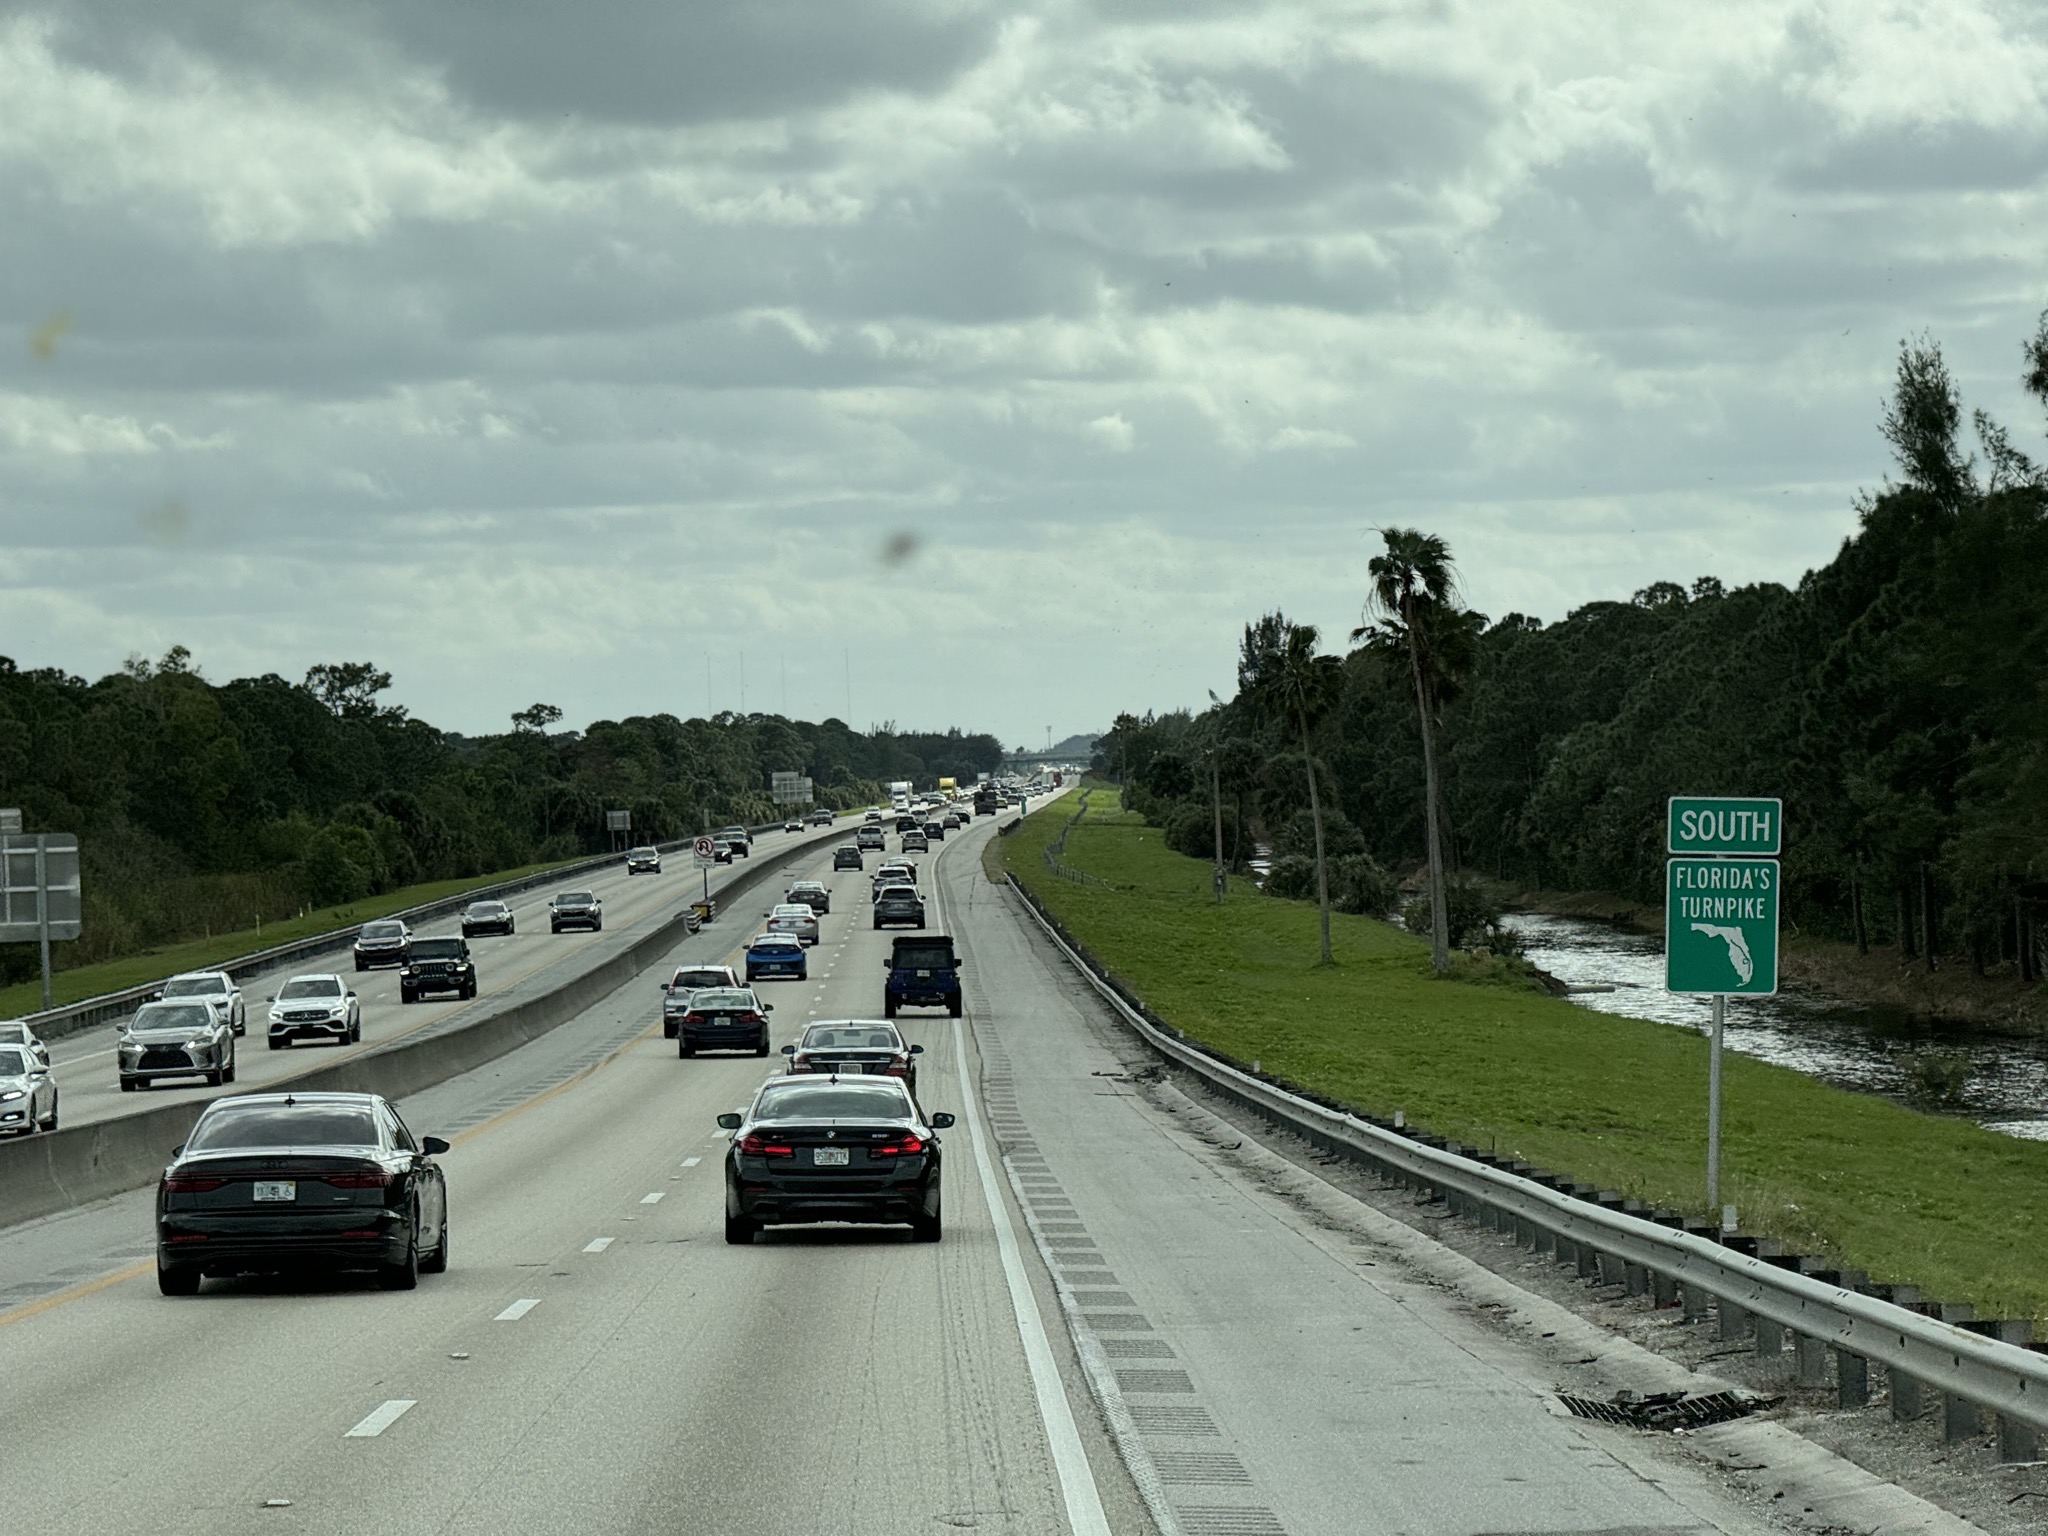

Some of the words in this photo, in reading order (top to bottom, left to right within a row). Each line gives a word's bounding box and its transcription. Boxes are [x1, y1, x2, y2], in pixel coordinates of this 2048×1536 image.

[1680, 810, 1770, 841] SOUTH
[1676, 867, 1770, 890] FLORIDA'S
[1680, 897, 1765, 919] TURNPIKE
